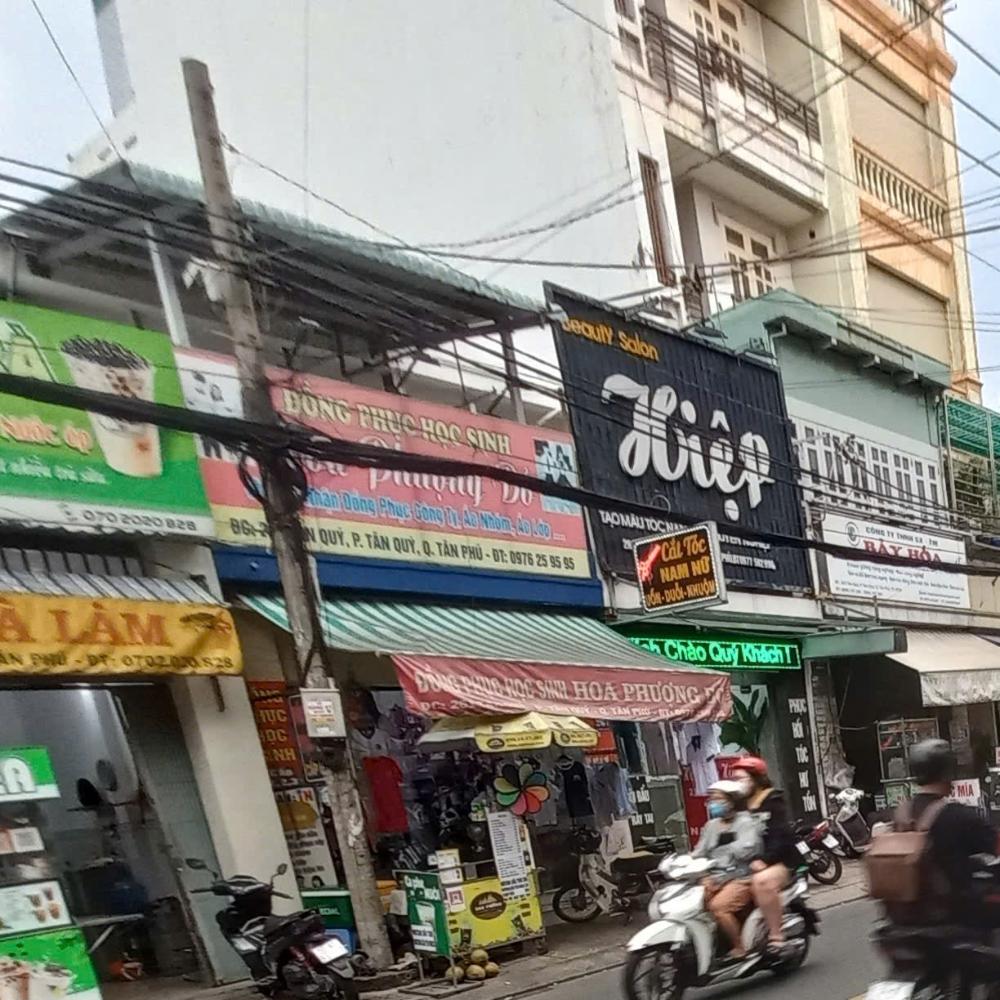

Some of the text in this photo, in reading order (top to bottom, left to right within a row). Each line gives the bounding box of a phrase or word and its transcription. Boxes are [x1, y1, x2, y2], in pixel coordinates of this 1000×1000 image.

[619, 329, 660, 361] Salon
[281, 380, 512, 455] ĐỒNG PHỤC HỌC SINH
[601, 373, 775, 521] Hiệp
[352, 532, 364, 548] P.
[365, 530, 391, 550] TÂN
[422, 541, 435, 557] Q.
[437, 539, 460, 558] TÂN
[510, 550, 534, 566] 0976
[536, 553, 548, 566] 25
[549, 555, 561, 568] 95
[563, 557, 575, 570] 95
[660, 563, 690, 583] NAM
[664, 640, 707, 662] Chào
[709, 641, 739, 666] Quý
[742, 643, 784, 664] Khách
[537, 679, 569, 700] SINH
[622, 682, 701, 708] PHƯỢNG
[957, 783, 975, 798] MÍA
